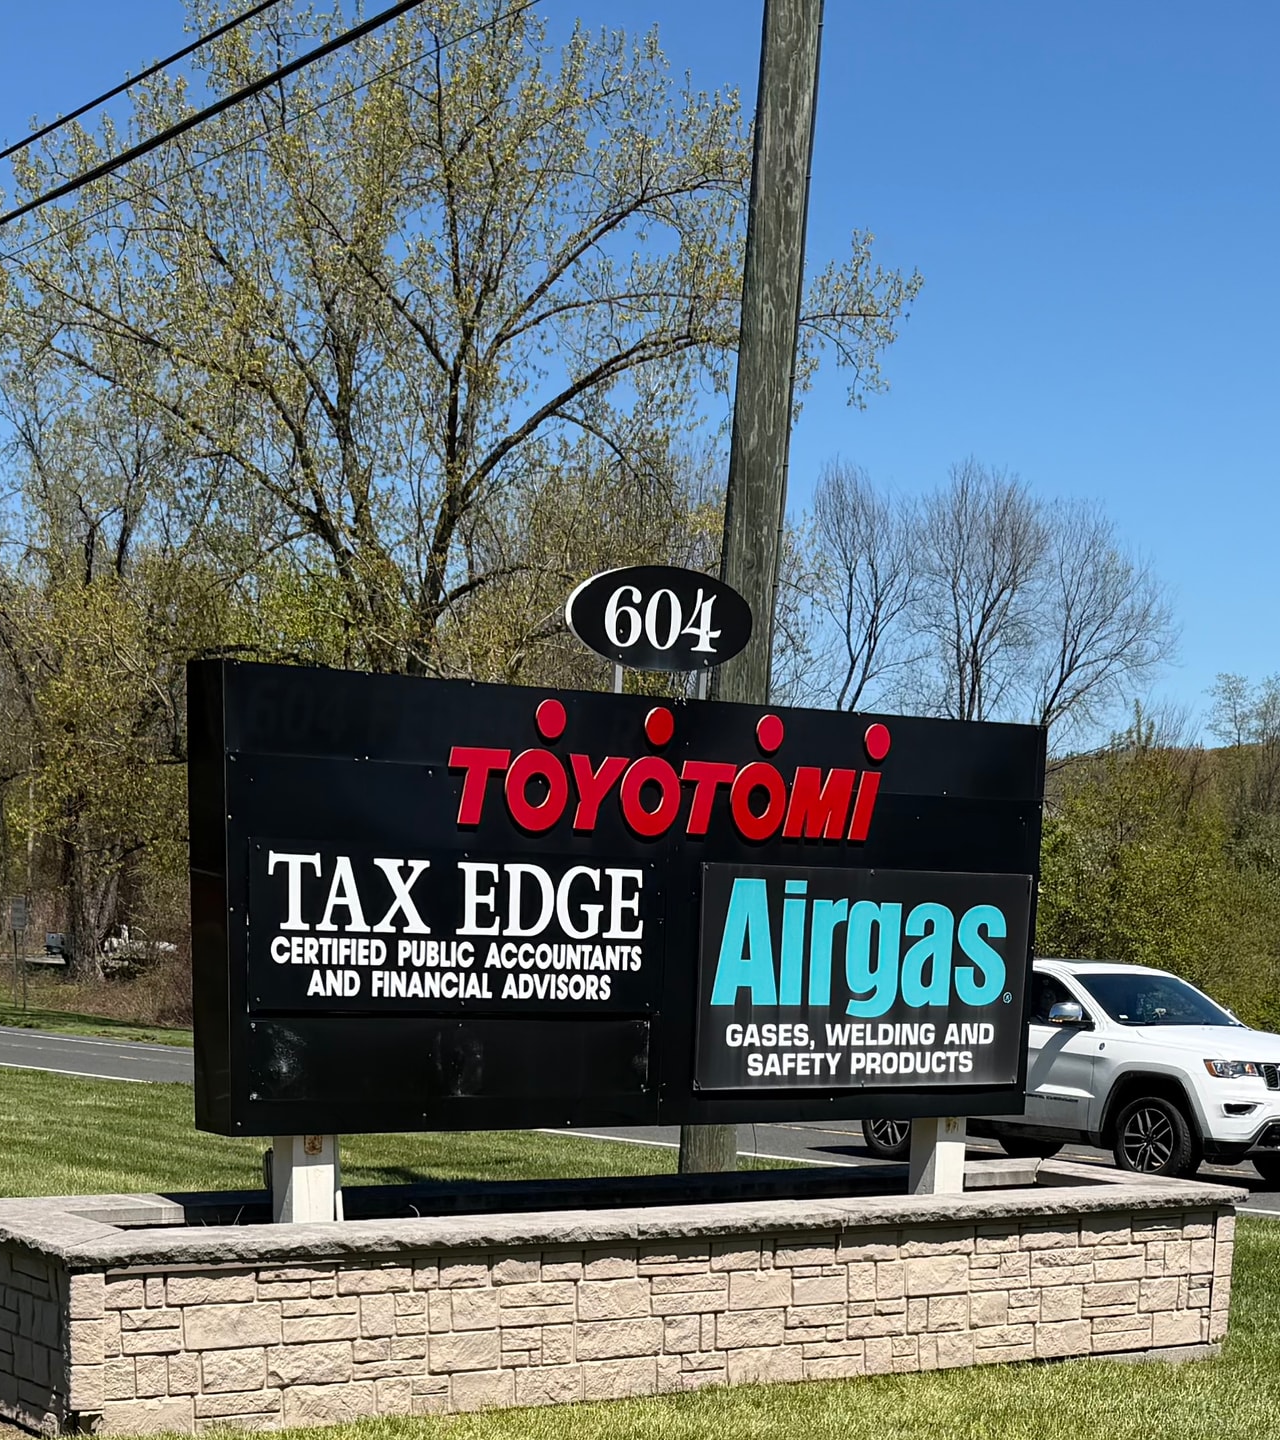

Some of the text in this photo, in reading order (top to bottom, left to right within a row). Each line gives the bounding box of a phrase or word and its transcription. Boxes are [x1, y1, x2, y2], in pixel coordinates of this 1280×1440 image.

[605, 586, 721, 653] 604
[449, 699, 891, 841] TOYOTOMI
[268, 850, 644, 940] TAX EDGE
[270, 937, 643, 973] CERTIFIED PUBLIC ACCOUNTANTS
[307, 970, 612, 1001] AND FINANCIAL ADVISORS
[726, 1022, 995, 1052] GASES, WELDING AND
[747, 1050, 974, 1077] SAFETY PRODUCTS
